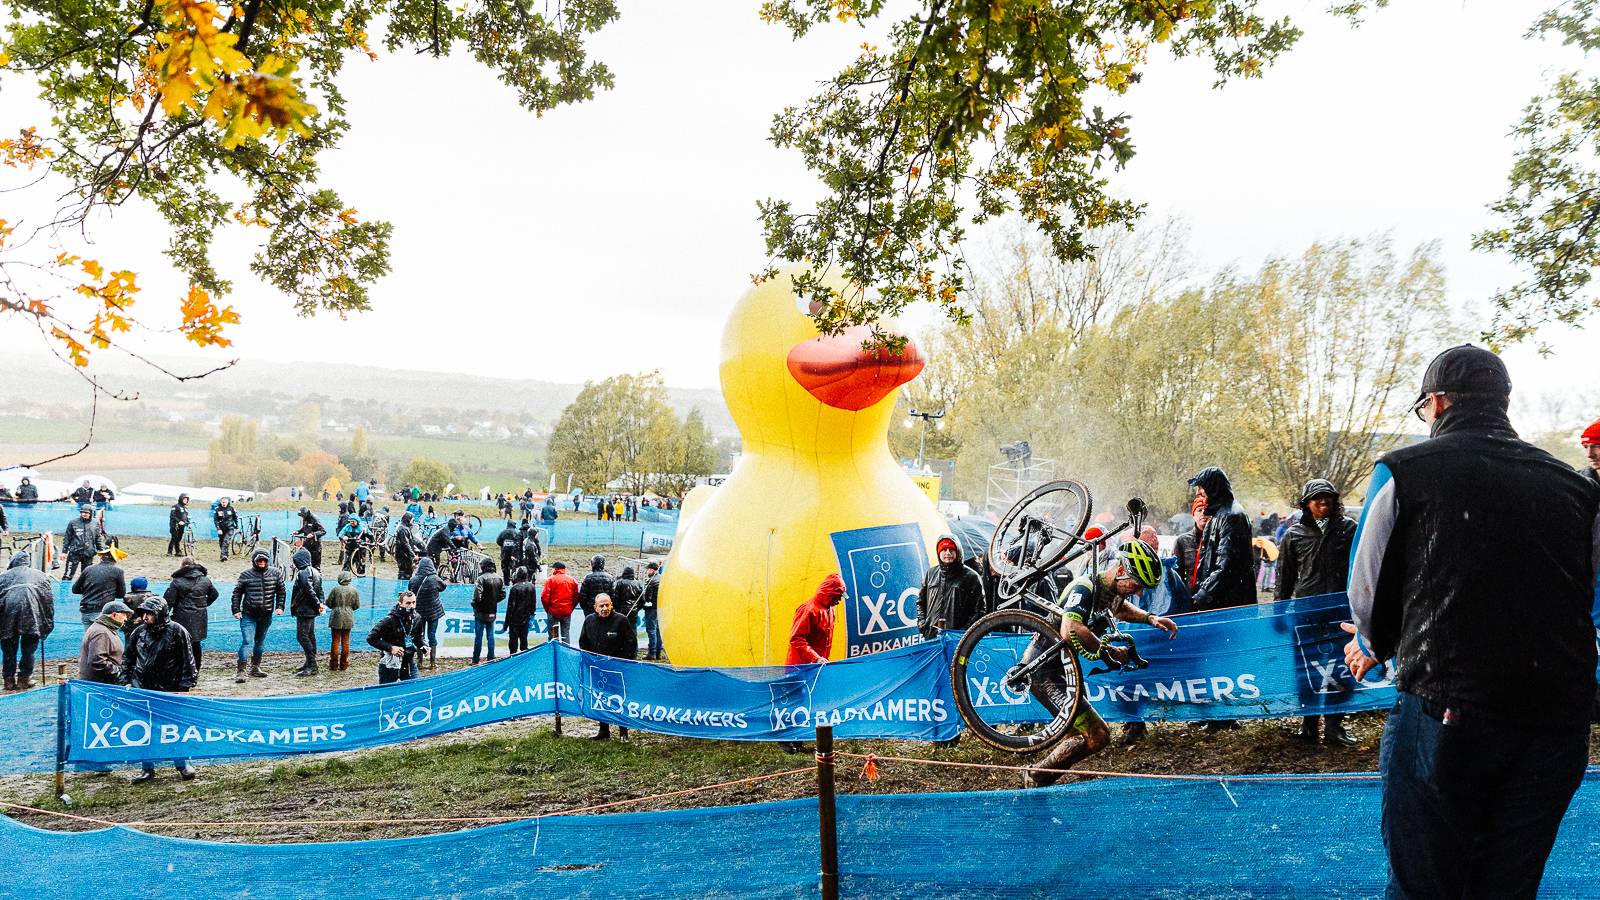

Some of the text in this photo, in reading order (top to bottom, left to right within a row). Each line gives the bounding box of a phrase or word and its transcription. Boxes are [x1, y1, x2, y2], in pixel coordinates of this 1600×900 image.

[850, 634, 925, 656] BADKAMER
[437, 681, 575, 721] BADKAMERS
[1083, 673, 1260, 703] DKAMERS
[627, 702, 748, 728] BADKAMERS
[814, 699, 948, 727] BADKAMERS
[160, 723, 347, 745] BADKAMERS
